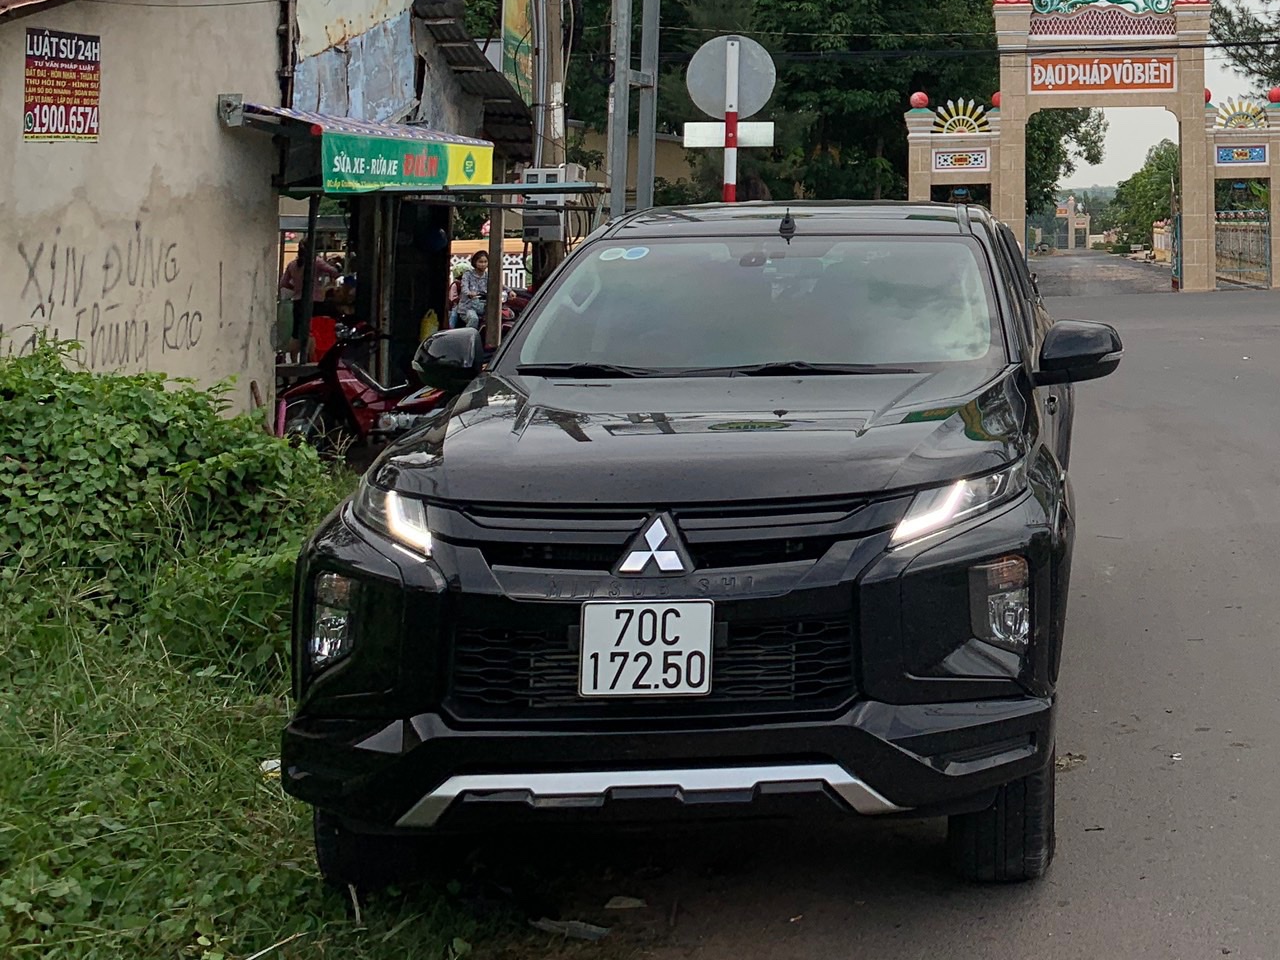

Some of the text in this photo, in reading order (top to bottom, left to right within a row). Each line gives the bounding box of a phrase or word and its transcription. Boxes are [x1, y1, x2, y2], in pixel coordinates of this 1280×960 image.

[26, 30, 100, 61] LUẬT SƯ 24H
[1033, 63, 1066, 90] ĐẠO
[1067, 58, 1112, 85] PHÁP
[1133, 58, 1171, 85] BIÊN
[33, 104, 99, 133] 1900.6574
[333, 151, 351, 174] SỬA
[352, 157, 366, 175] XE
[386, 158, 399, 176] XE
[546, 576, 754, 600] MITSUBSHI
[614, 607, 682, 647] 70C
[589, 650, 706, 690] 172.50
